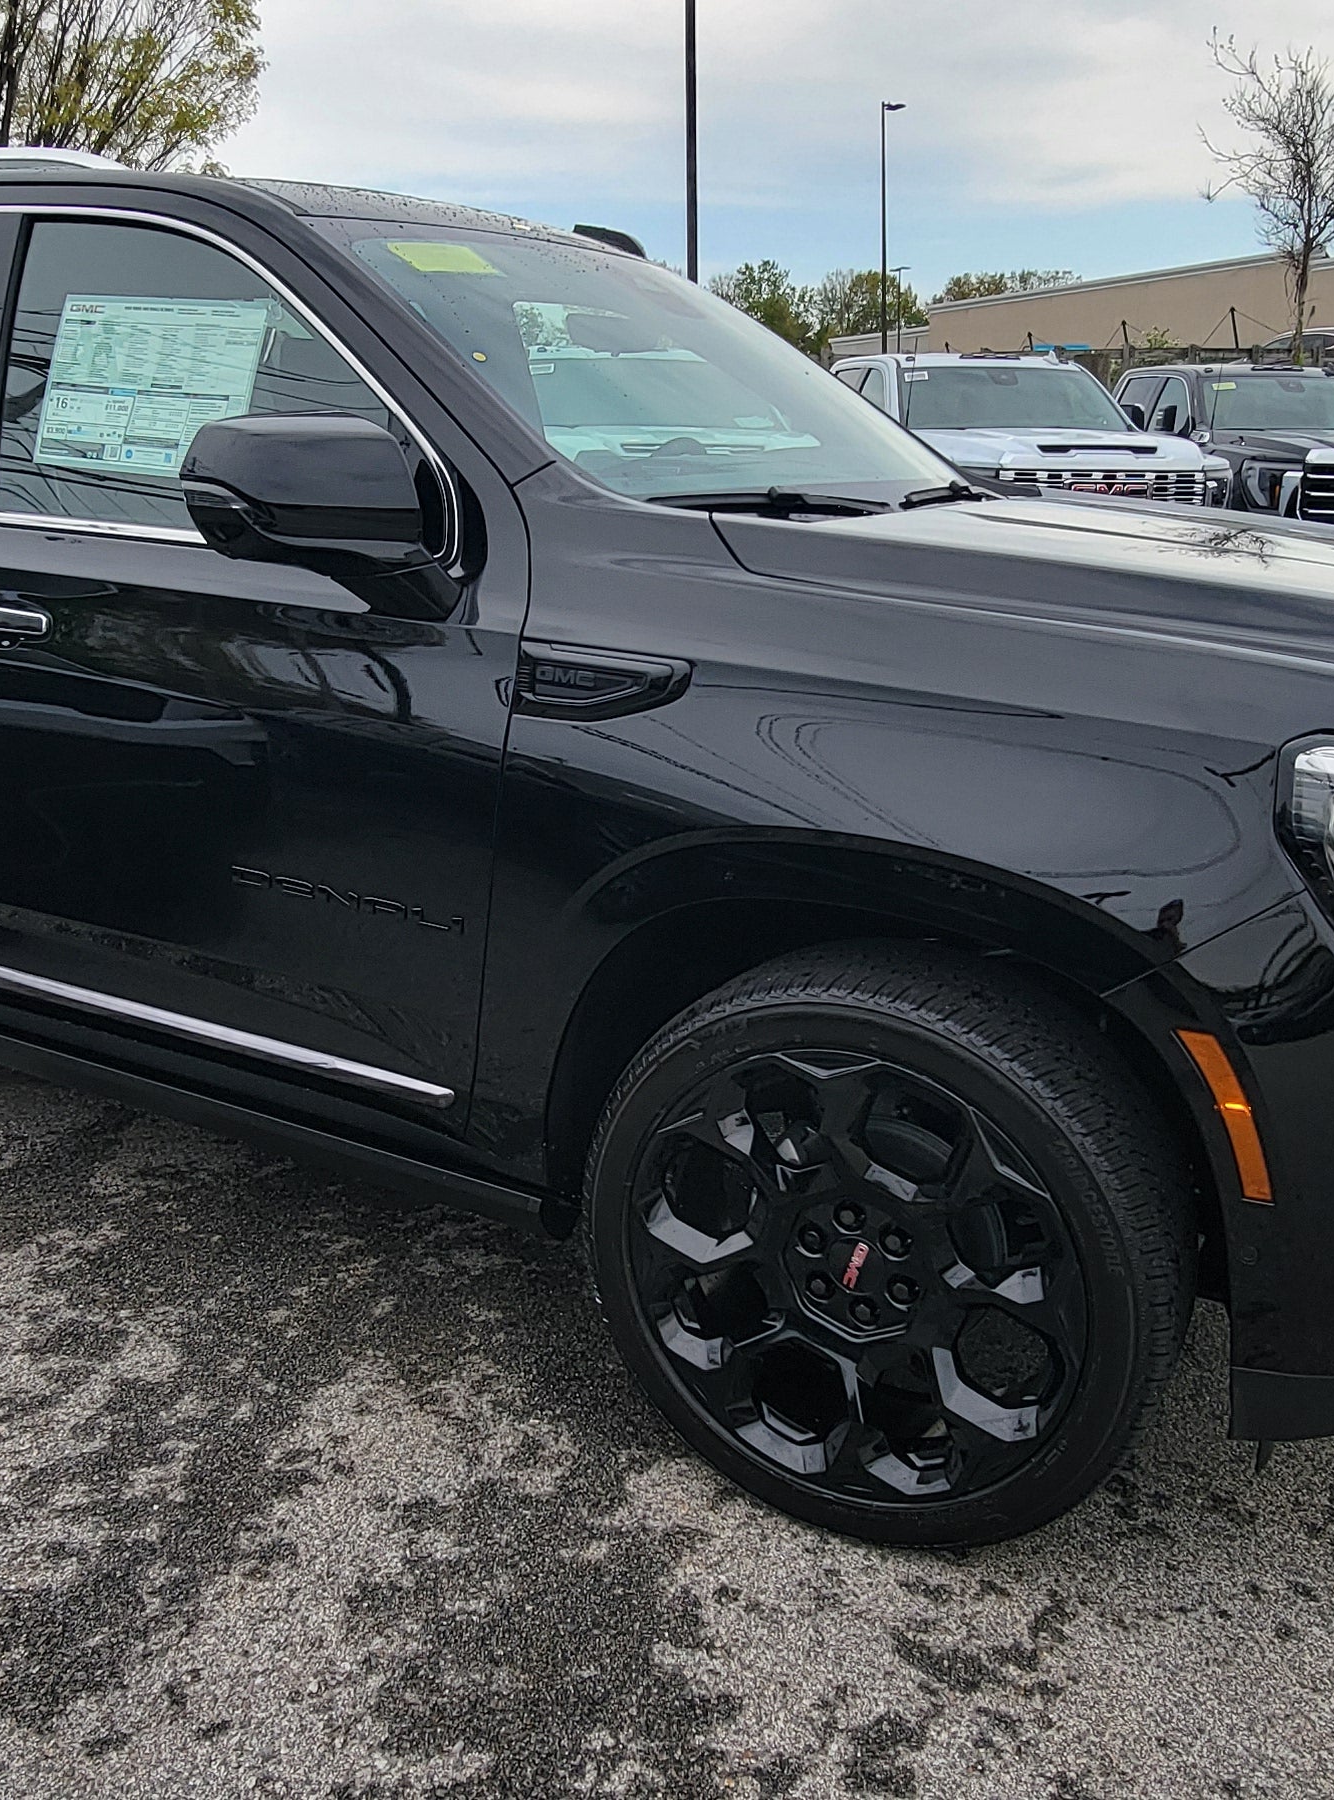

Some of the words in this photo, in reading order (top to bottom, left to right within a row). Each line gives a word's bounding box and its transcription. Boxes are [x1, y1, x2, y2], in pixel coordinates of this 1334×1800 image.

[70, 304, 105, 314] GMC
[55, 396, 69, 409] 16
[535, 665, 597, 688] GMC
[232, 865, 464, 934] DENALI
[842, 1242, 870, 1290] GMC
